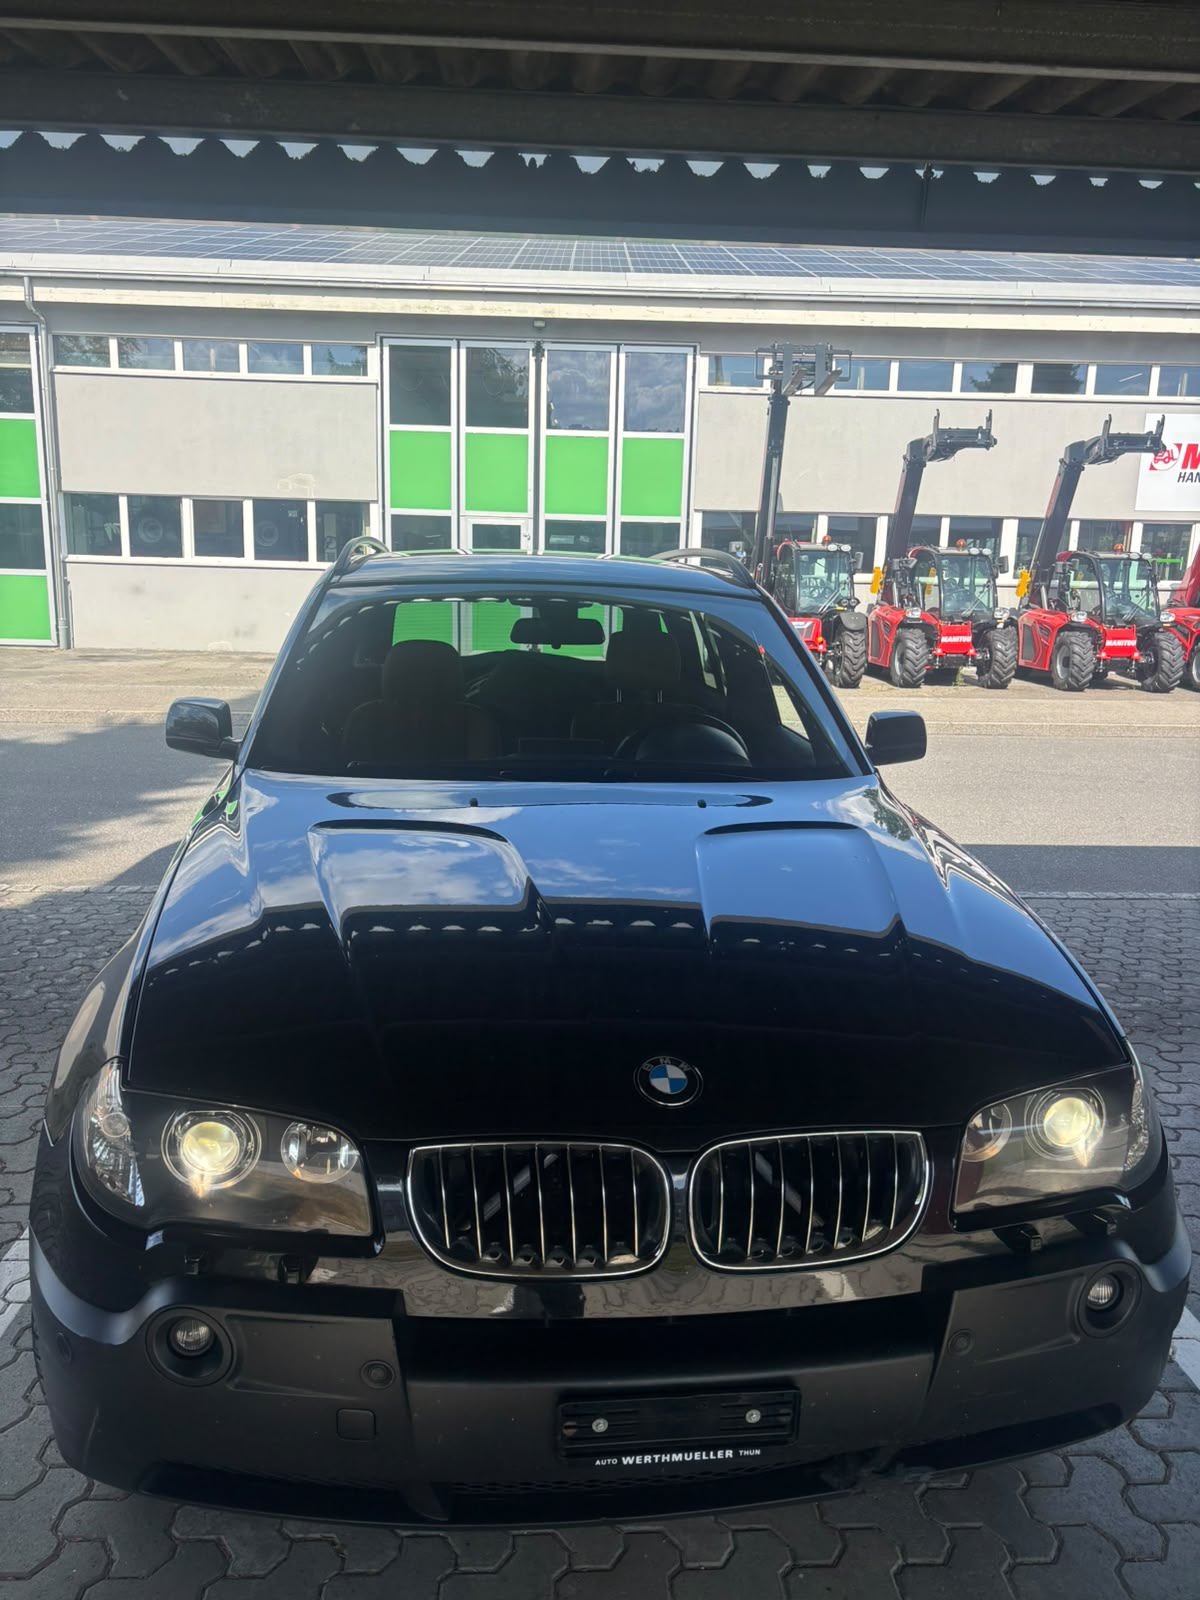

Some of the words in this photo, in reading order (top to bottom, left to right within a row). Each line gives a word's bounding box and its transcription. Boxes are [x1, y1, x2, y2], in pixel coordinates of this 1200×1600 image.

[941, 635, 972, 643] MANITOU
[1105, 639, 1137, 647] MANITOU
[642, 1056, 691, 1072] BMW
[595, 1458, 618, 1466] AUTO
[622, 1449, 733, 1465] WERTHMUELLER
[739, 1449, 761, 1457] THUN
